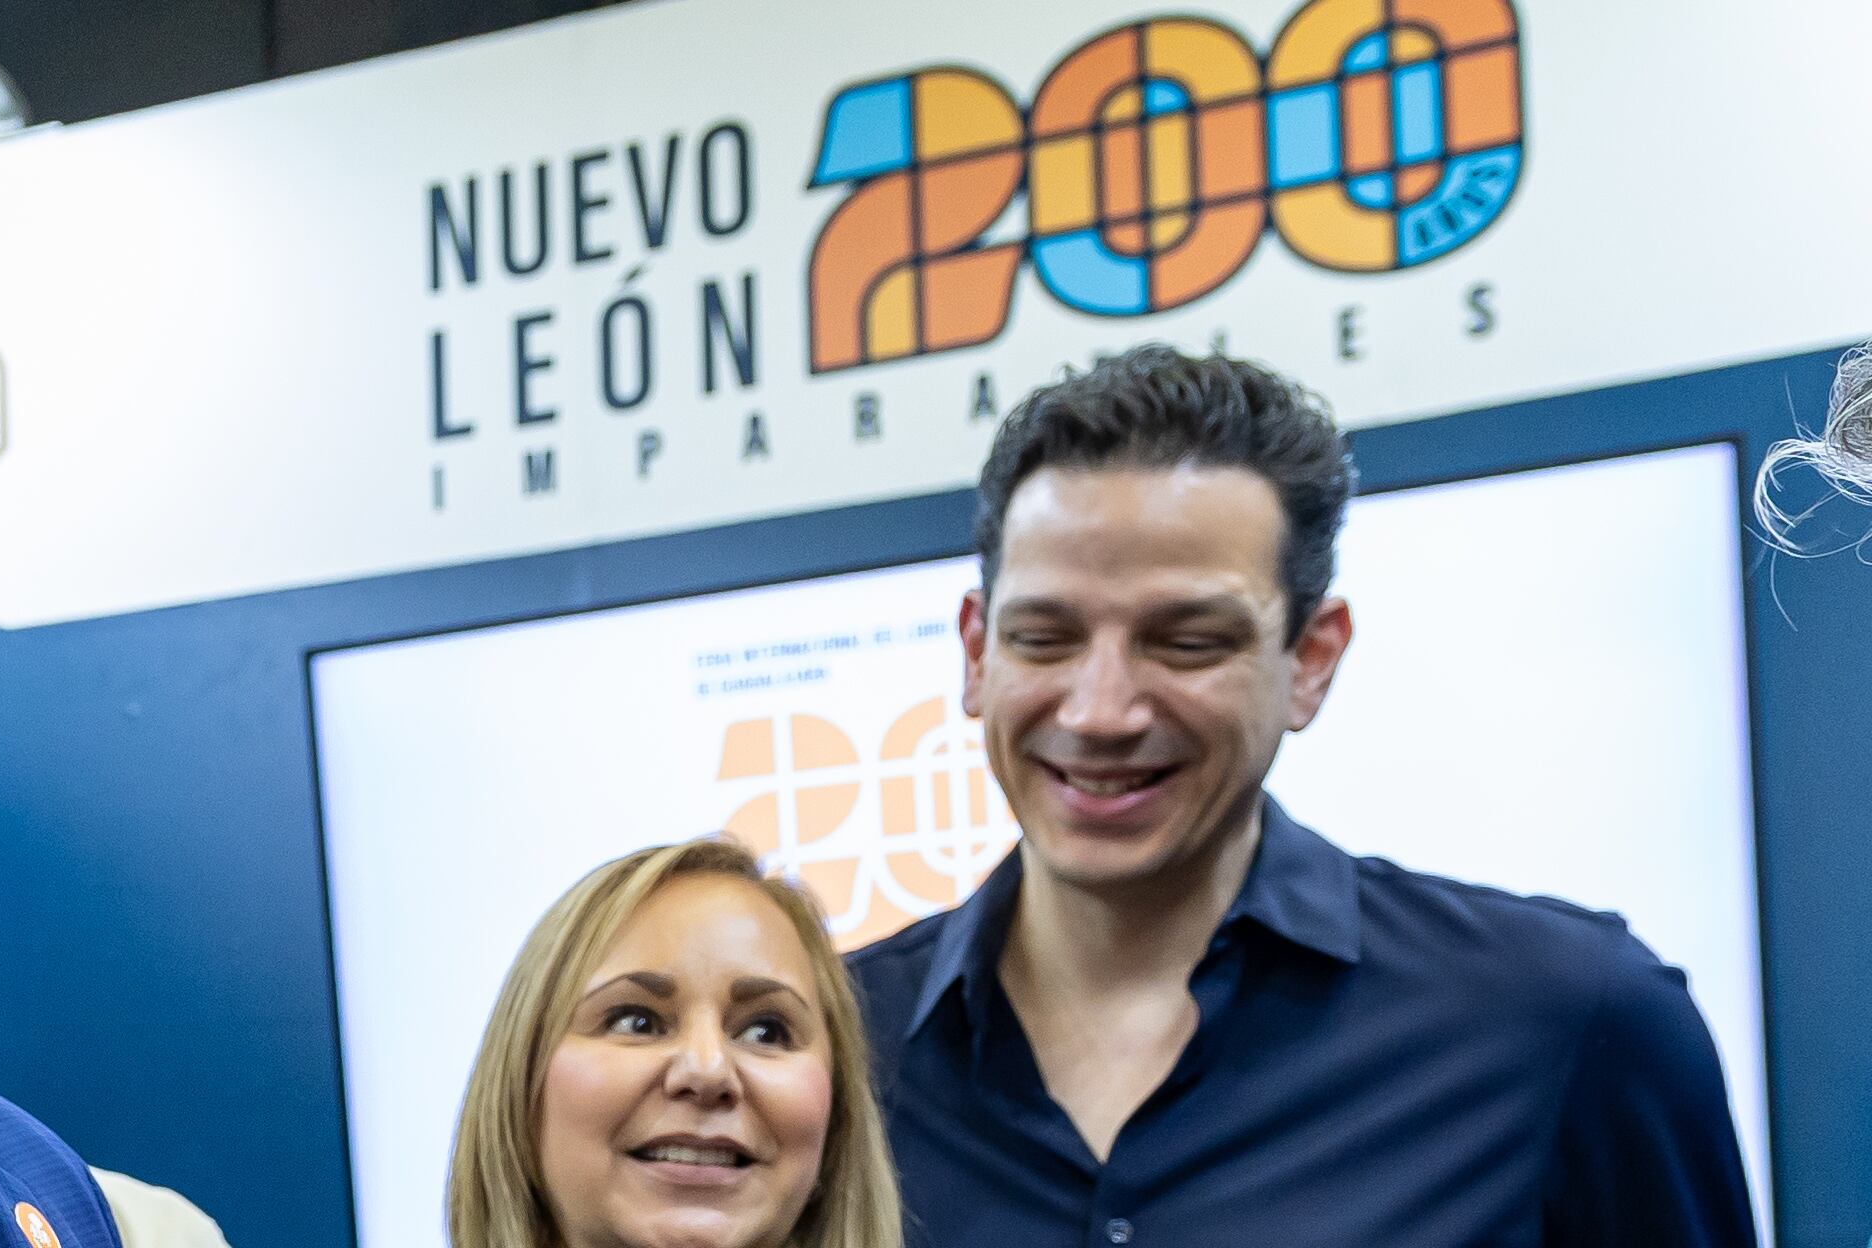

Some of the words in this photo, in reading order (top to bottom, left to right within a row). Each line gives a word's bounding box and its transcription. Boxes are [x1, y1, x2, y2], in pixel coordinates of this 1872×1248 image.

[428, 119, 755, 291] NUEVO
[805, 0, 1526, 376] 200
[429, 267, 759, 442] LEÓN
[431, 284, 1498, 510] IMPARAES
